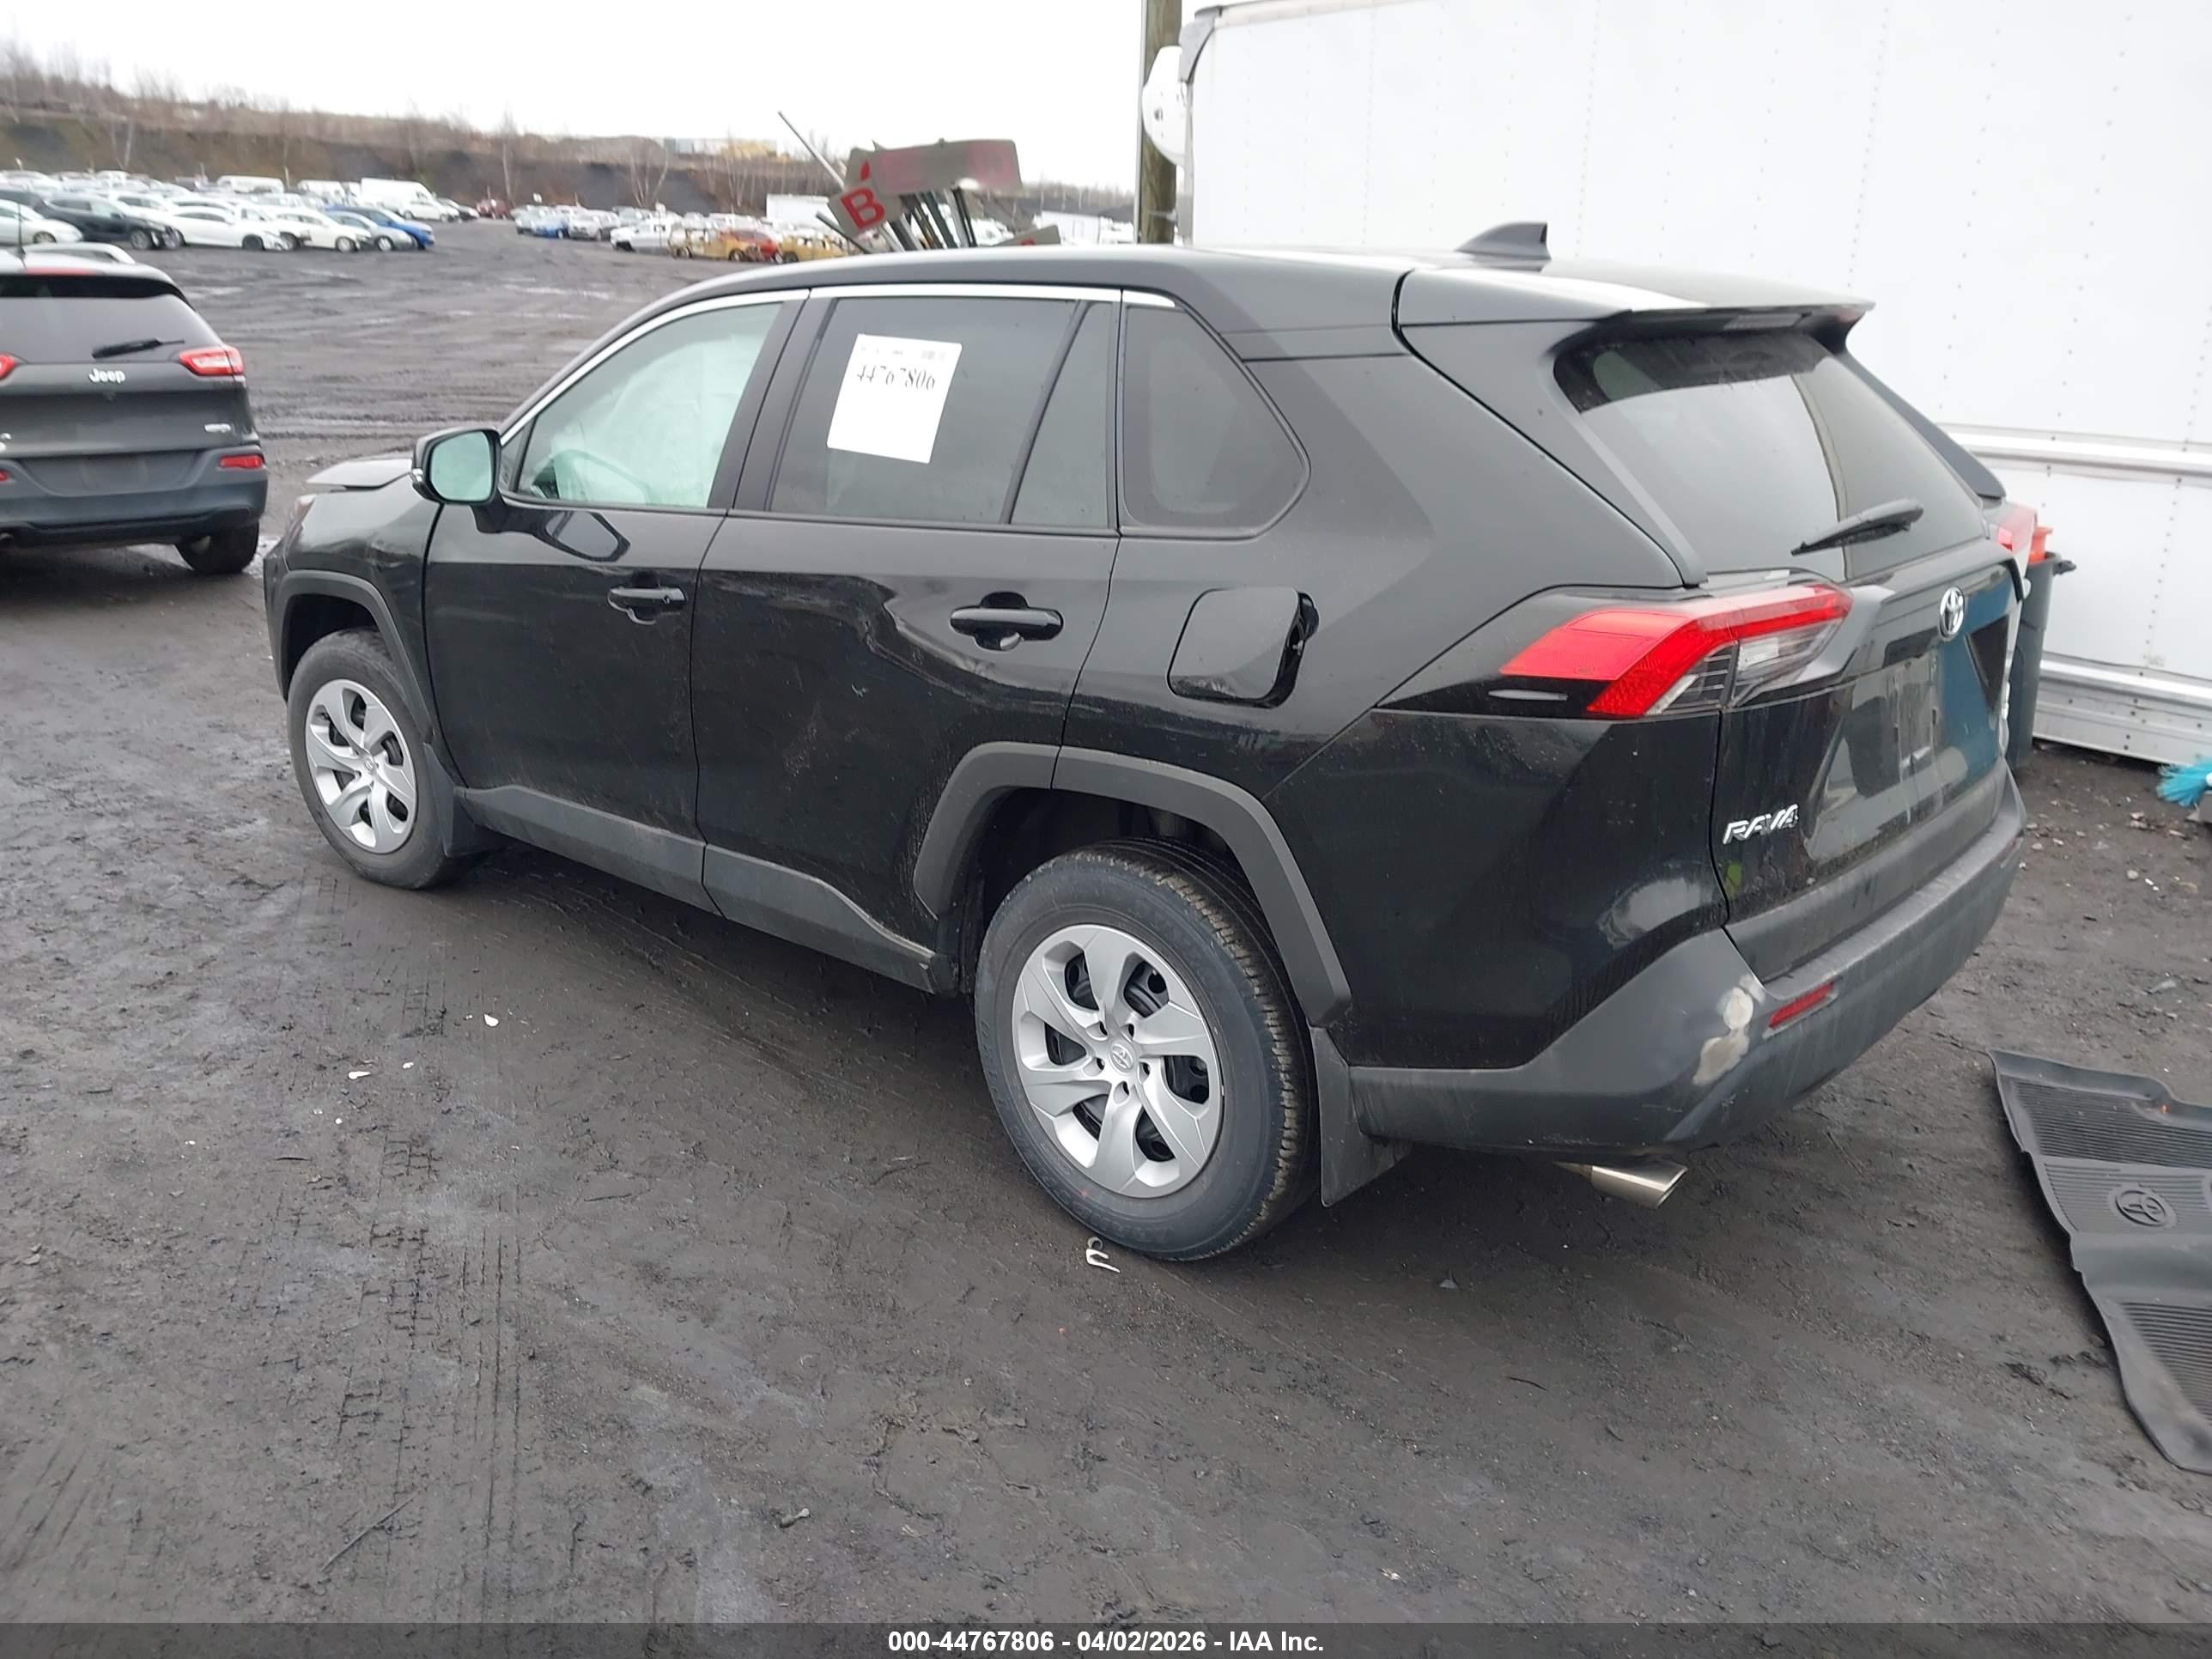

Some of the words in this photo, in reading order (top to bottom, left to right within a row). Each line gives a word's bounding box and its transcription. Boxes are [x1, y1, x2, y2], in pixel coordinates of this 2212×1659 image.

[841, 186, 886, 231] B
[88, 368, 126, 385] Jeep
[1723, 804, 1799, 845] RAV4
